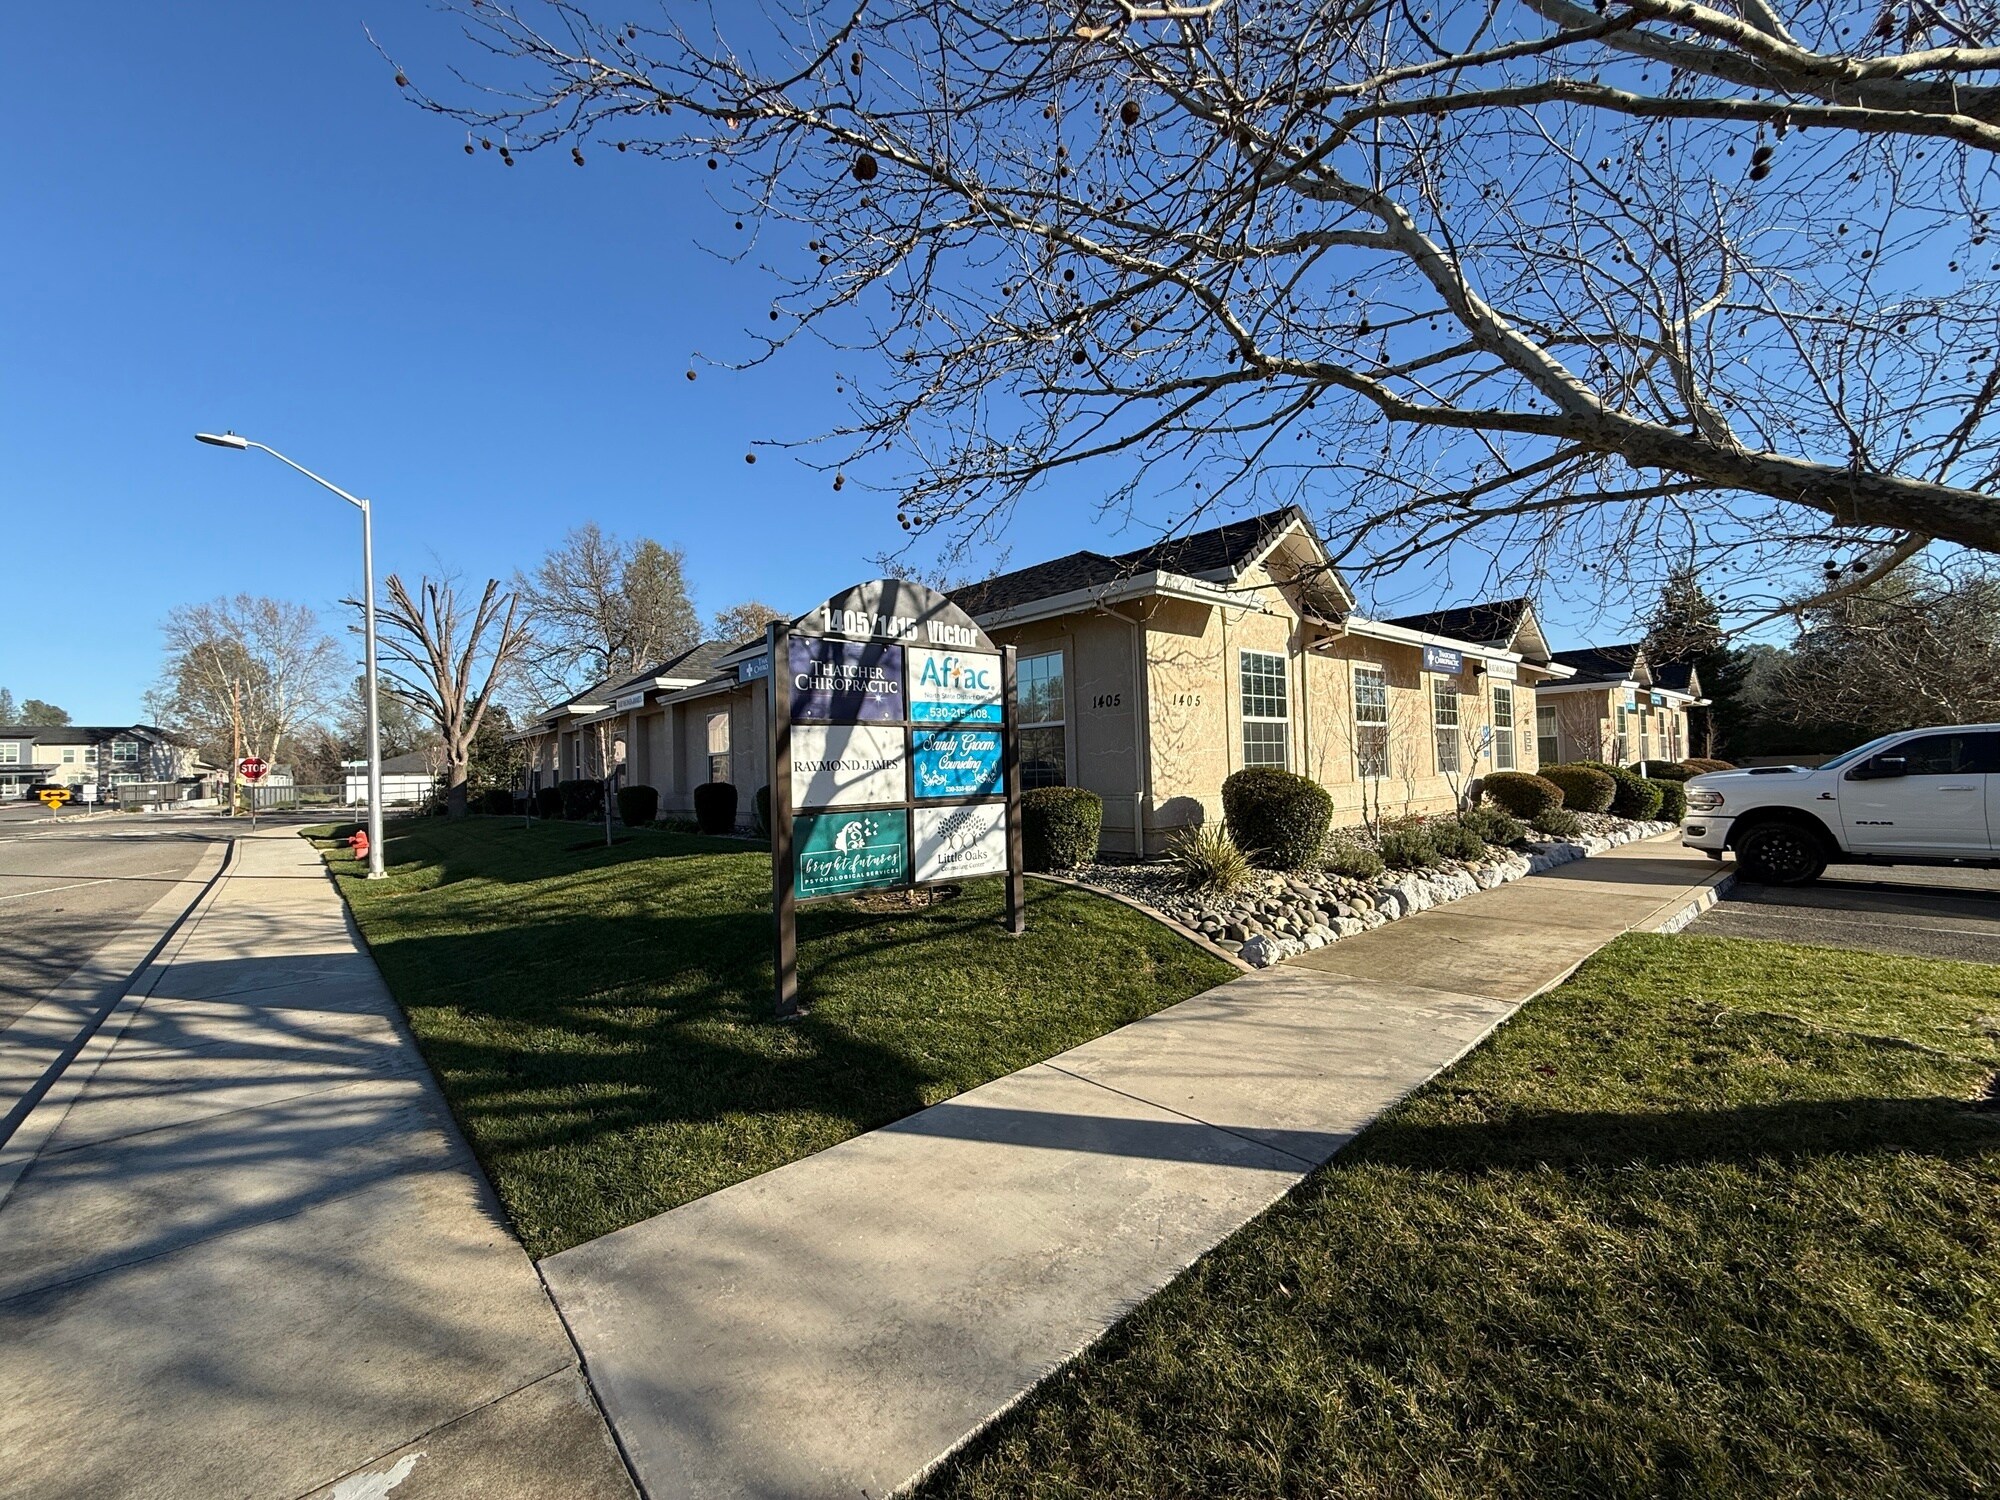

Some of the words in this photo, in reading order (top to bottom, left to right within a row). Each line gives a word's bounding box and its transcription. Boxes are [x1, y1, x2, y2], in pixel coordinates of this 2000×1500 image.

[821, 608, 918, 641] 1405/1415
[926, 620, 978, 647] Victor
[810, 660, 884, 680] THATCHER
[795, 674, 898, 694] CHIROPRACTIC
[1093, 693, 1121, 709] 1405
[1173, 693, 1201, 707] 1405
[929, 707, 988, 719] 530-215-1108
[922, 733, 958, 756] Sandy
[960, 733, 996, 756] Groom
[241, 763, 267, 773] STOP
[793, 760, 860, 772] RAYMOND
[862, 759, 899, 771] JAMES
[938, 755, 982, 772] Counseling
[848, 853, 899, 873] futures
[937, 851, 963, 864] Little
[964, 850, 988, 861] Oaks
[804, 872, 865, 884] PSYCHOLOGICAL
[865, 868, 899, 877] SERVICES
